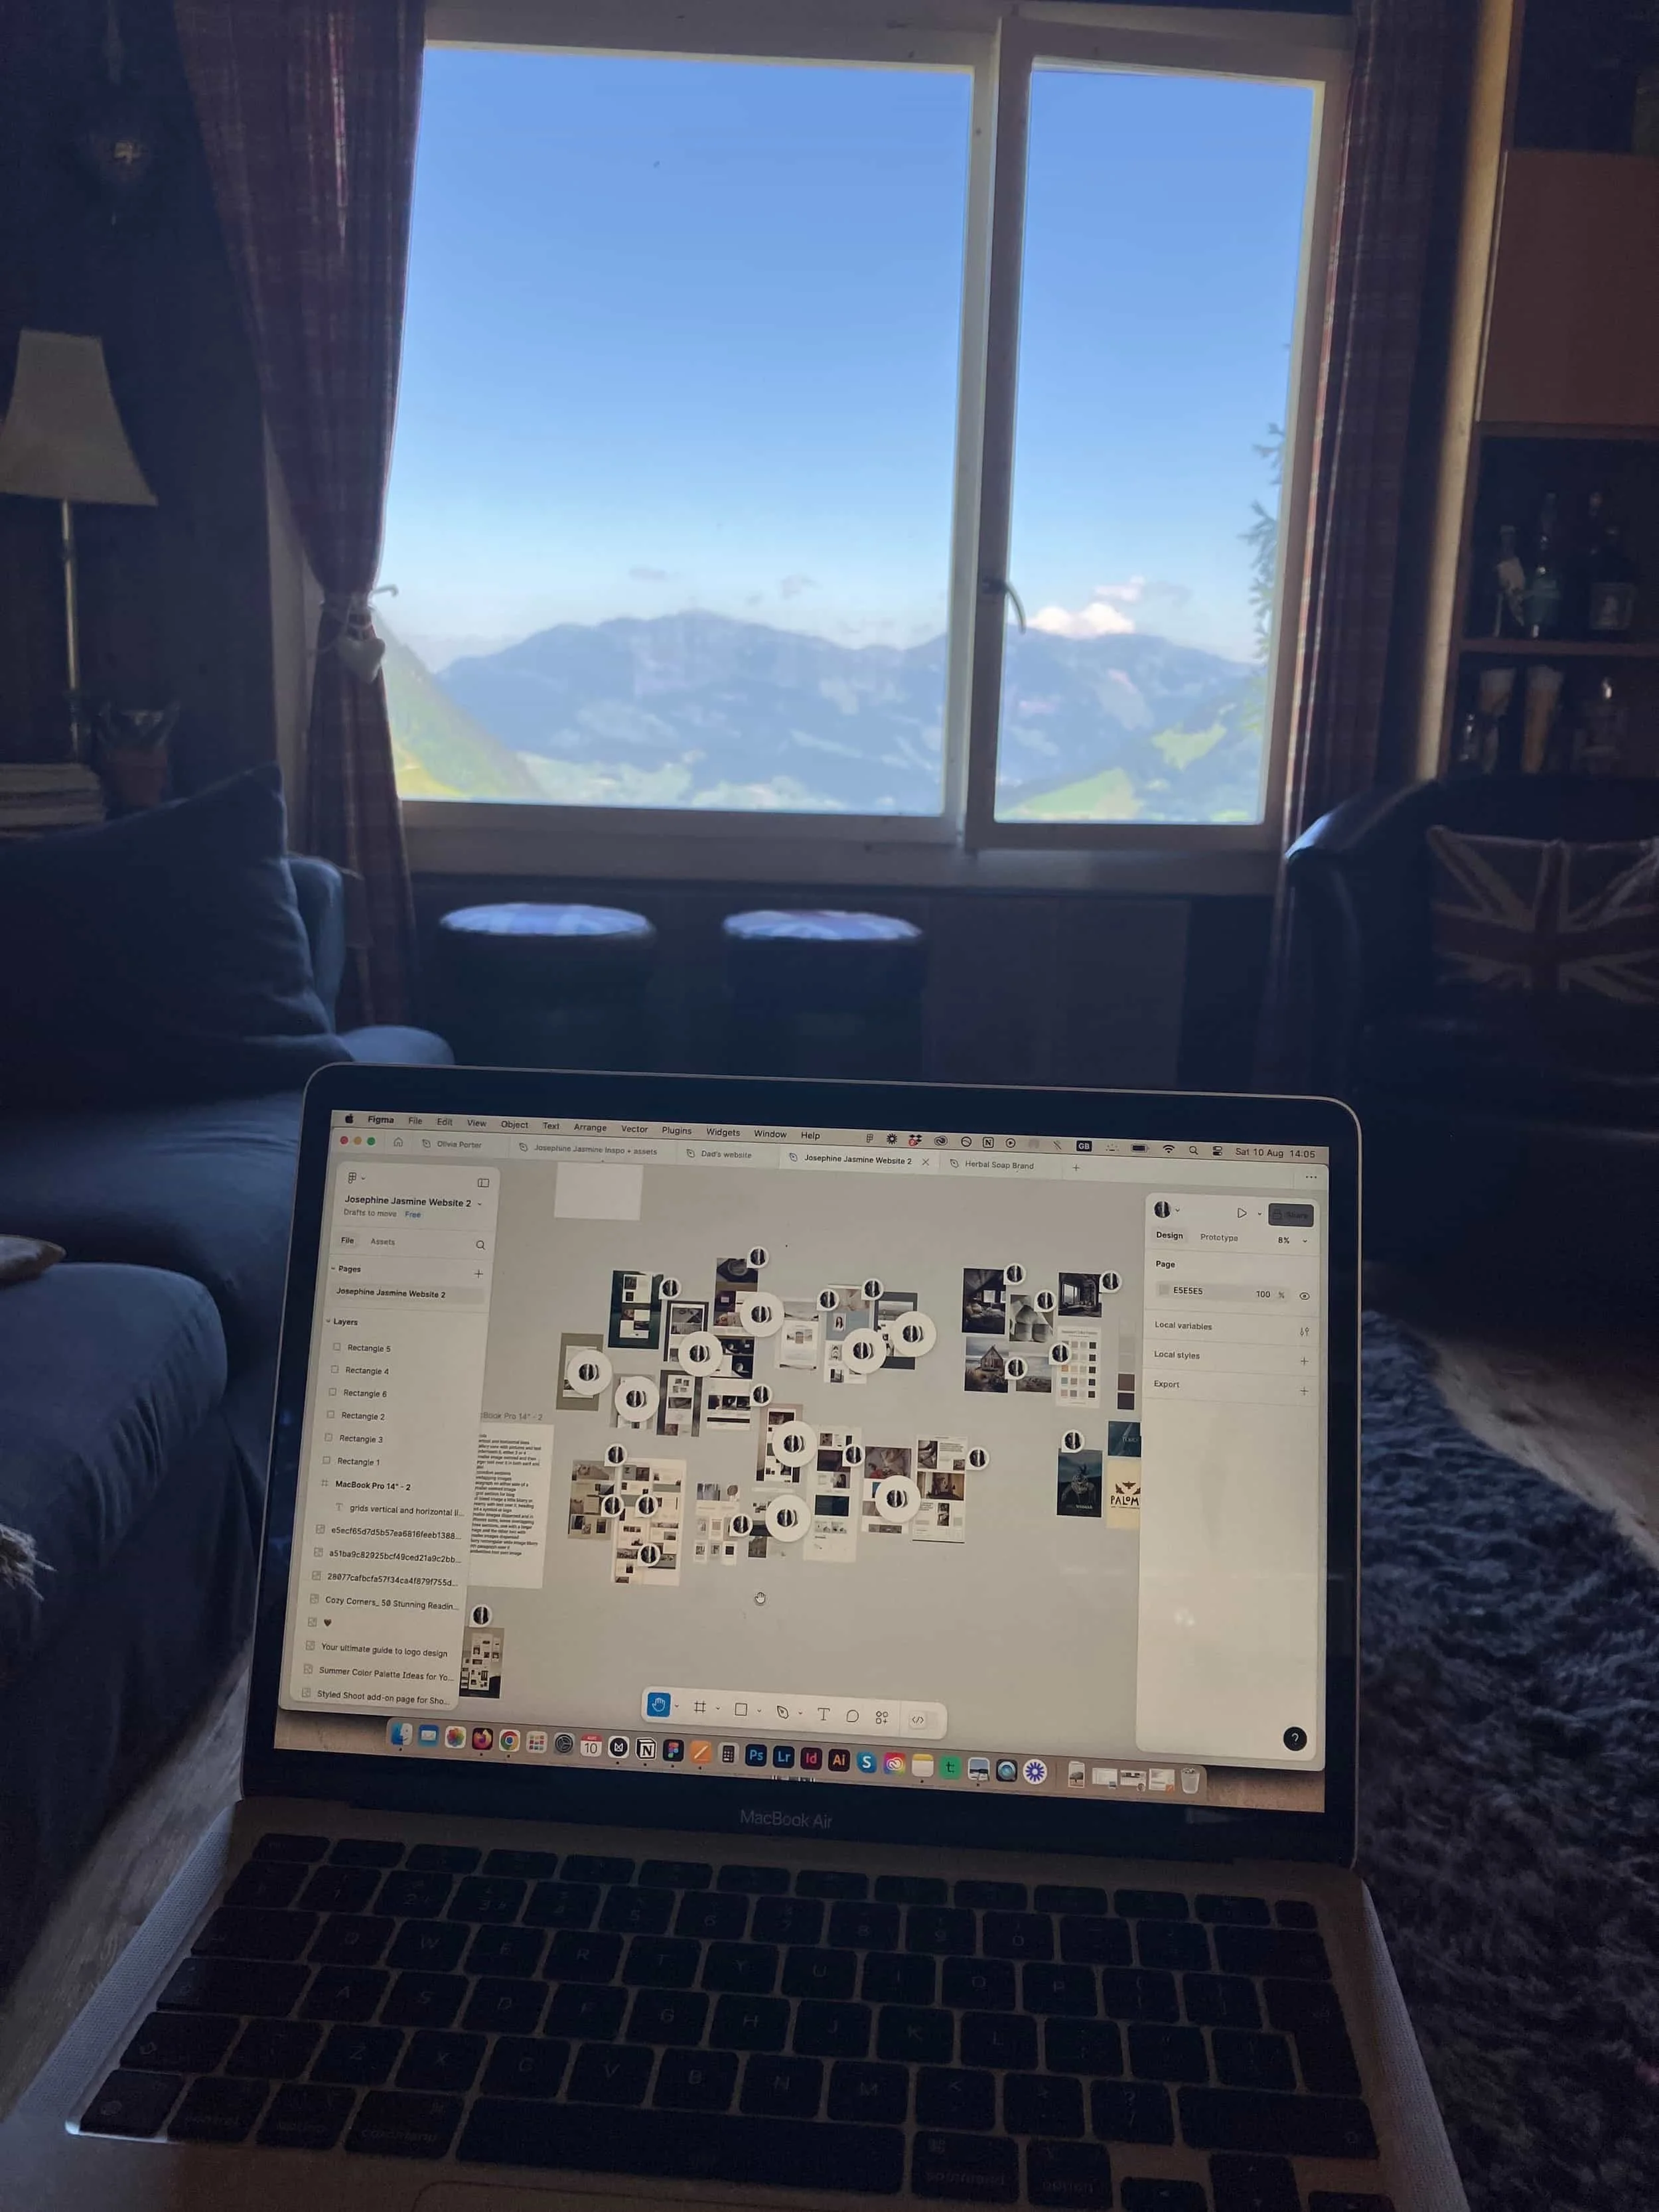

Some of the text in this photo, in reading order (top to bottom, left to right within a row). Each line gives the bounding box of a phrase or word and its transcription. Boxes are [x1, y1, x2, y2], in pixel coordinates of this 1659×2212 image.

[368, 1116, 394, 1125] Figma
[501, 1120, 528, 1130] Object
[574, 1124, 607, 1132] Arrange
[662, 1126, 691, 1136] Plugins
[707, 1128, 741, 1137] Widgets
[801, 1132, 820, 1141] Help
[1236, 1147, 1250, 1157] Sat
[1253, 1148, 1264, 1157] 10
[1267, 1149, 1283, 1159] Aug
[804, 1154, 841, 1163] Josephine
[991, 1161, 1010, 1171] Soap
[345, 1195, 389, 1205] Josephine
[391, 1197, 426, 1206] Jasmine
[429, 1198, 464, 1207] Website
[1156, 1232, 1183, 1240] Design
[1200, 1233, 1238, 1243] Prototype
[338, 1266, 361, 1274] Pages
[1156, 1261, 1175, 1270] Page
[336, 1288, 374, 1296] Josephine
[1177, 1322, 1212, 1331] variables
[348, 1344, 384, 1354] Rectangle
[1177, 1352, 1200, 1361] styles
[345, 1366, 382, 1376] Rectangle
[1154, 1380, 1180, 1389] Export
[344, 1389, 380, 1398] Rectangle
[342, 1412, 378, 1421] Rectangle
[340, 1435, 376, 1444] Rectangle
[337, 1457, 374, 1467] Rectangle
[336, 1481, 370, 1489] MacBook
[325, 1596, 344, 1605] Cozy
[393, 1600, 426, 1610] Stunning
[372, 1646, 393, 1655] guide
[405, 1648, 421, 1657] logo
[423, 1649, 447, 1658] design
[319, 1667, 349, 1676] Summer
[352, 1668, 373, 1677] Color
[374, 1670, 400, 1679] Palette
[402, 1671, 424, 1680] Ideas
[317, 1690, 342, 1700] Styled
[367, 1694, 394, 1703] add-on
[396, 1696, 415, 1705] page
[584, 1743, 597, 1753] 10
[750, 1749, 763, 1761] Ps
[778, 1751, 791, 1763] Lr
[806, 1752, 818, 1764] Id
[833, 1754, 845, 1765] Ai
[863, 1756, 872, 1768] S
[946, 1761, 954, 1773] t
[740, 1809, 833, 1829] MacBook Air
